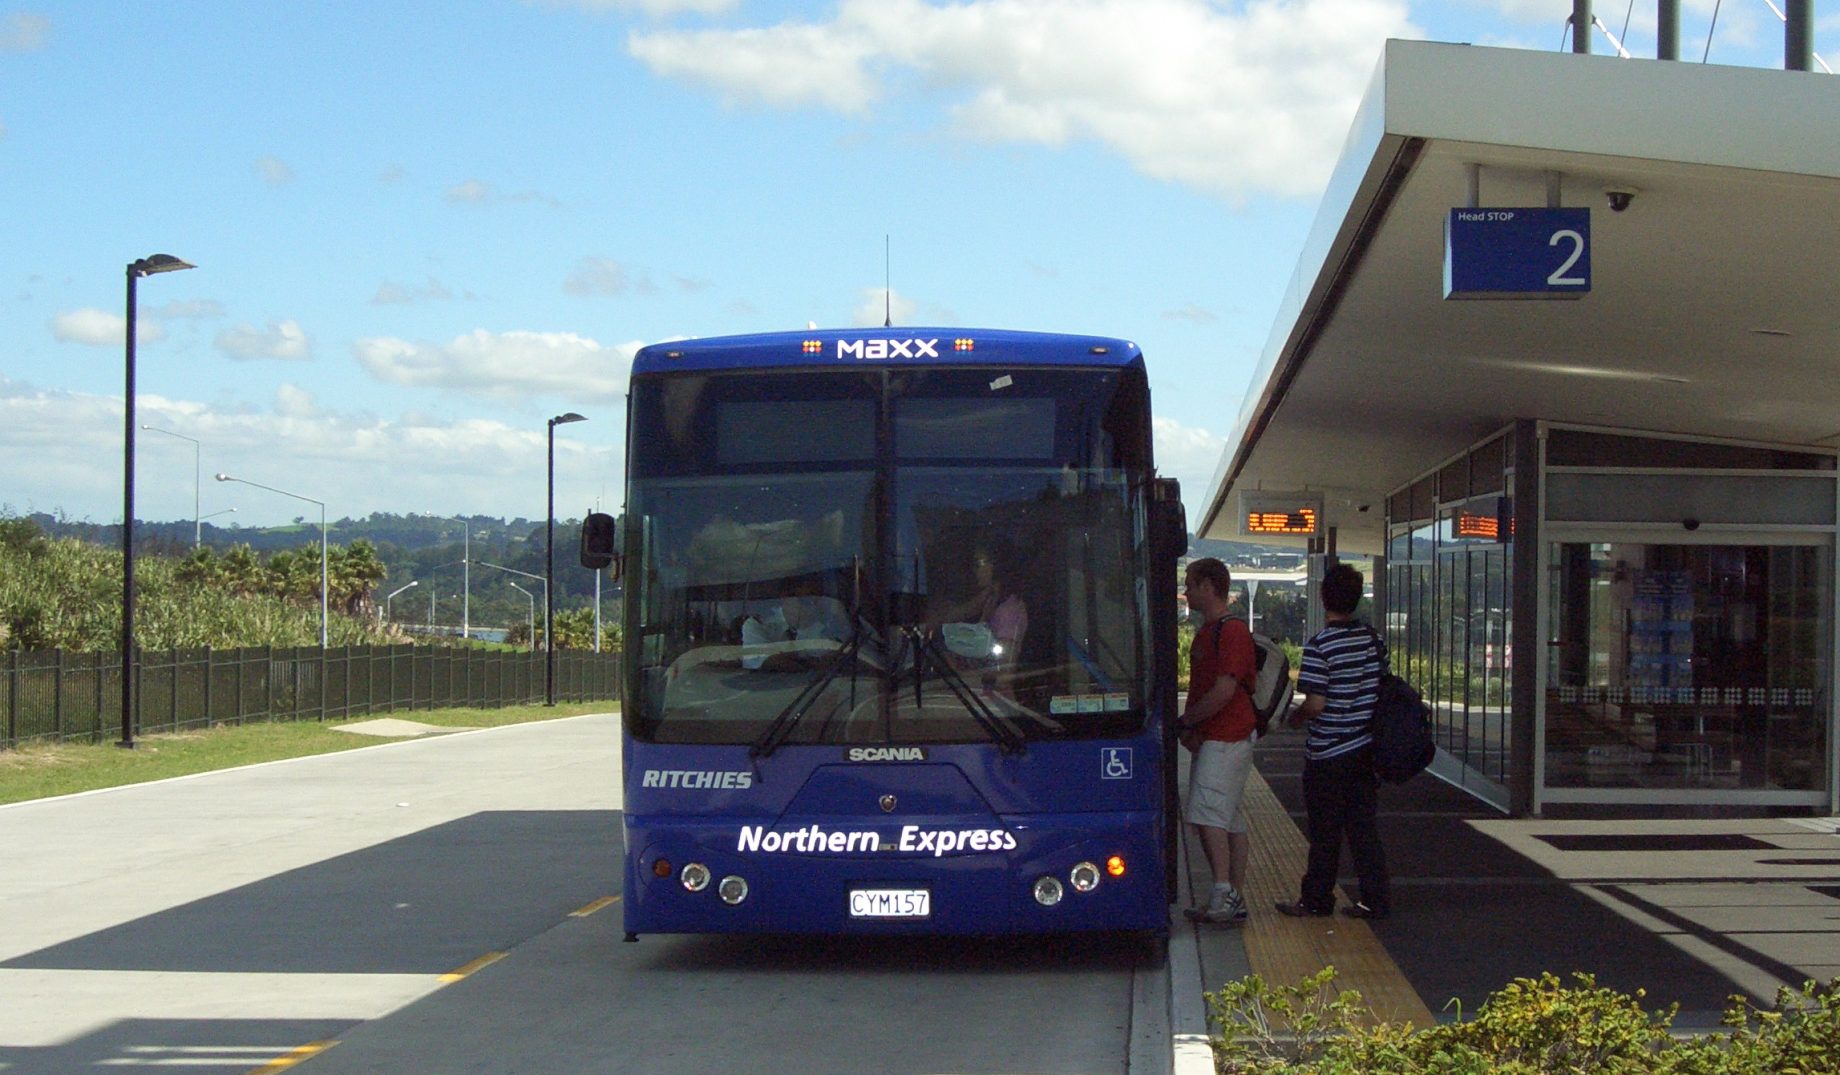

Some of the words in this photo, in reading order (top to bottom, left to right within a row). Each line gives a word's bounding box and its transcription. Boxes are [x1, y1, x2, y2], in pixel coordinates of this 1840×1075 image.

[1458, 212, 1484, 221] Head
[1487, 212, 1514, 221] STOP
[1547, 229, 1585, 285] 2
[849, 747, 924, 761] SCANIA
[642, 770, 752, 789] RITCHIES
[737, 824, 880, 852] Northern
[899, 825, 1017, 857] Express
[852, 893, 927, 914] CYM157
